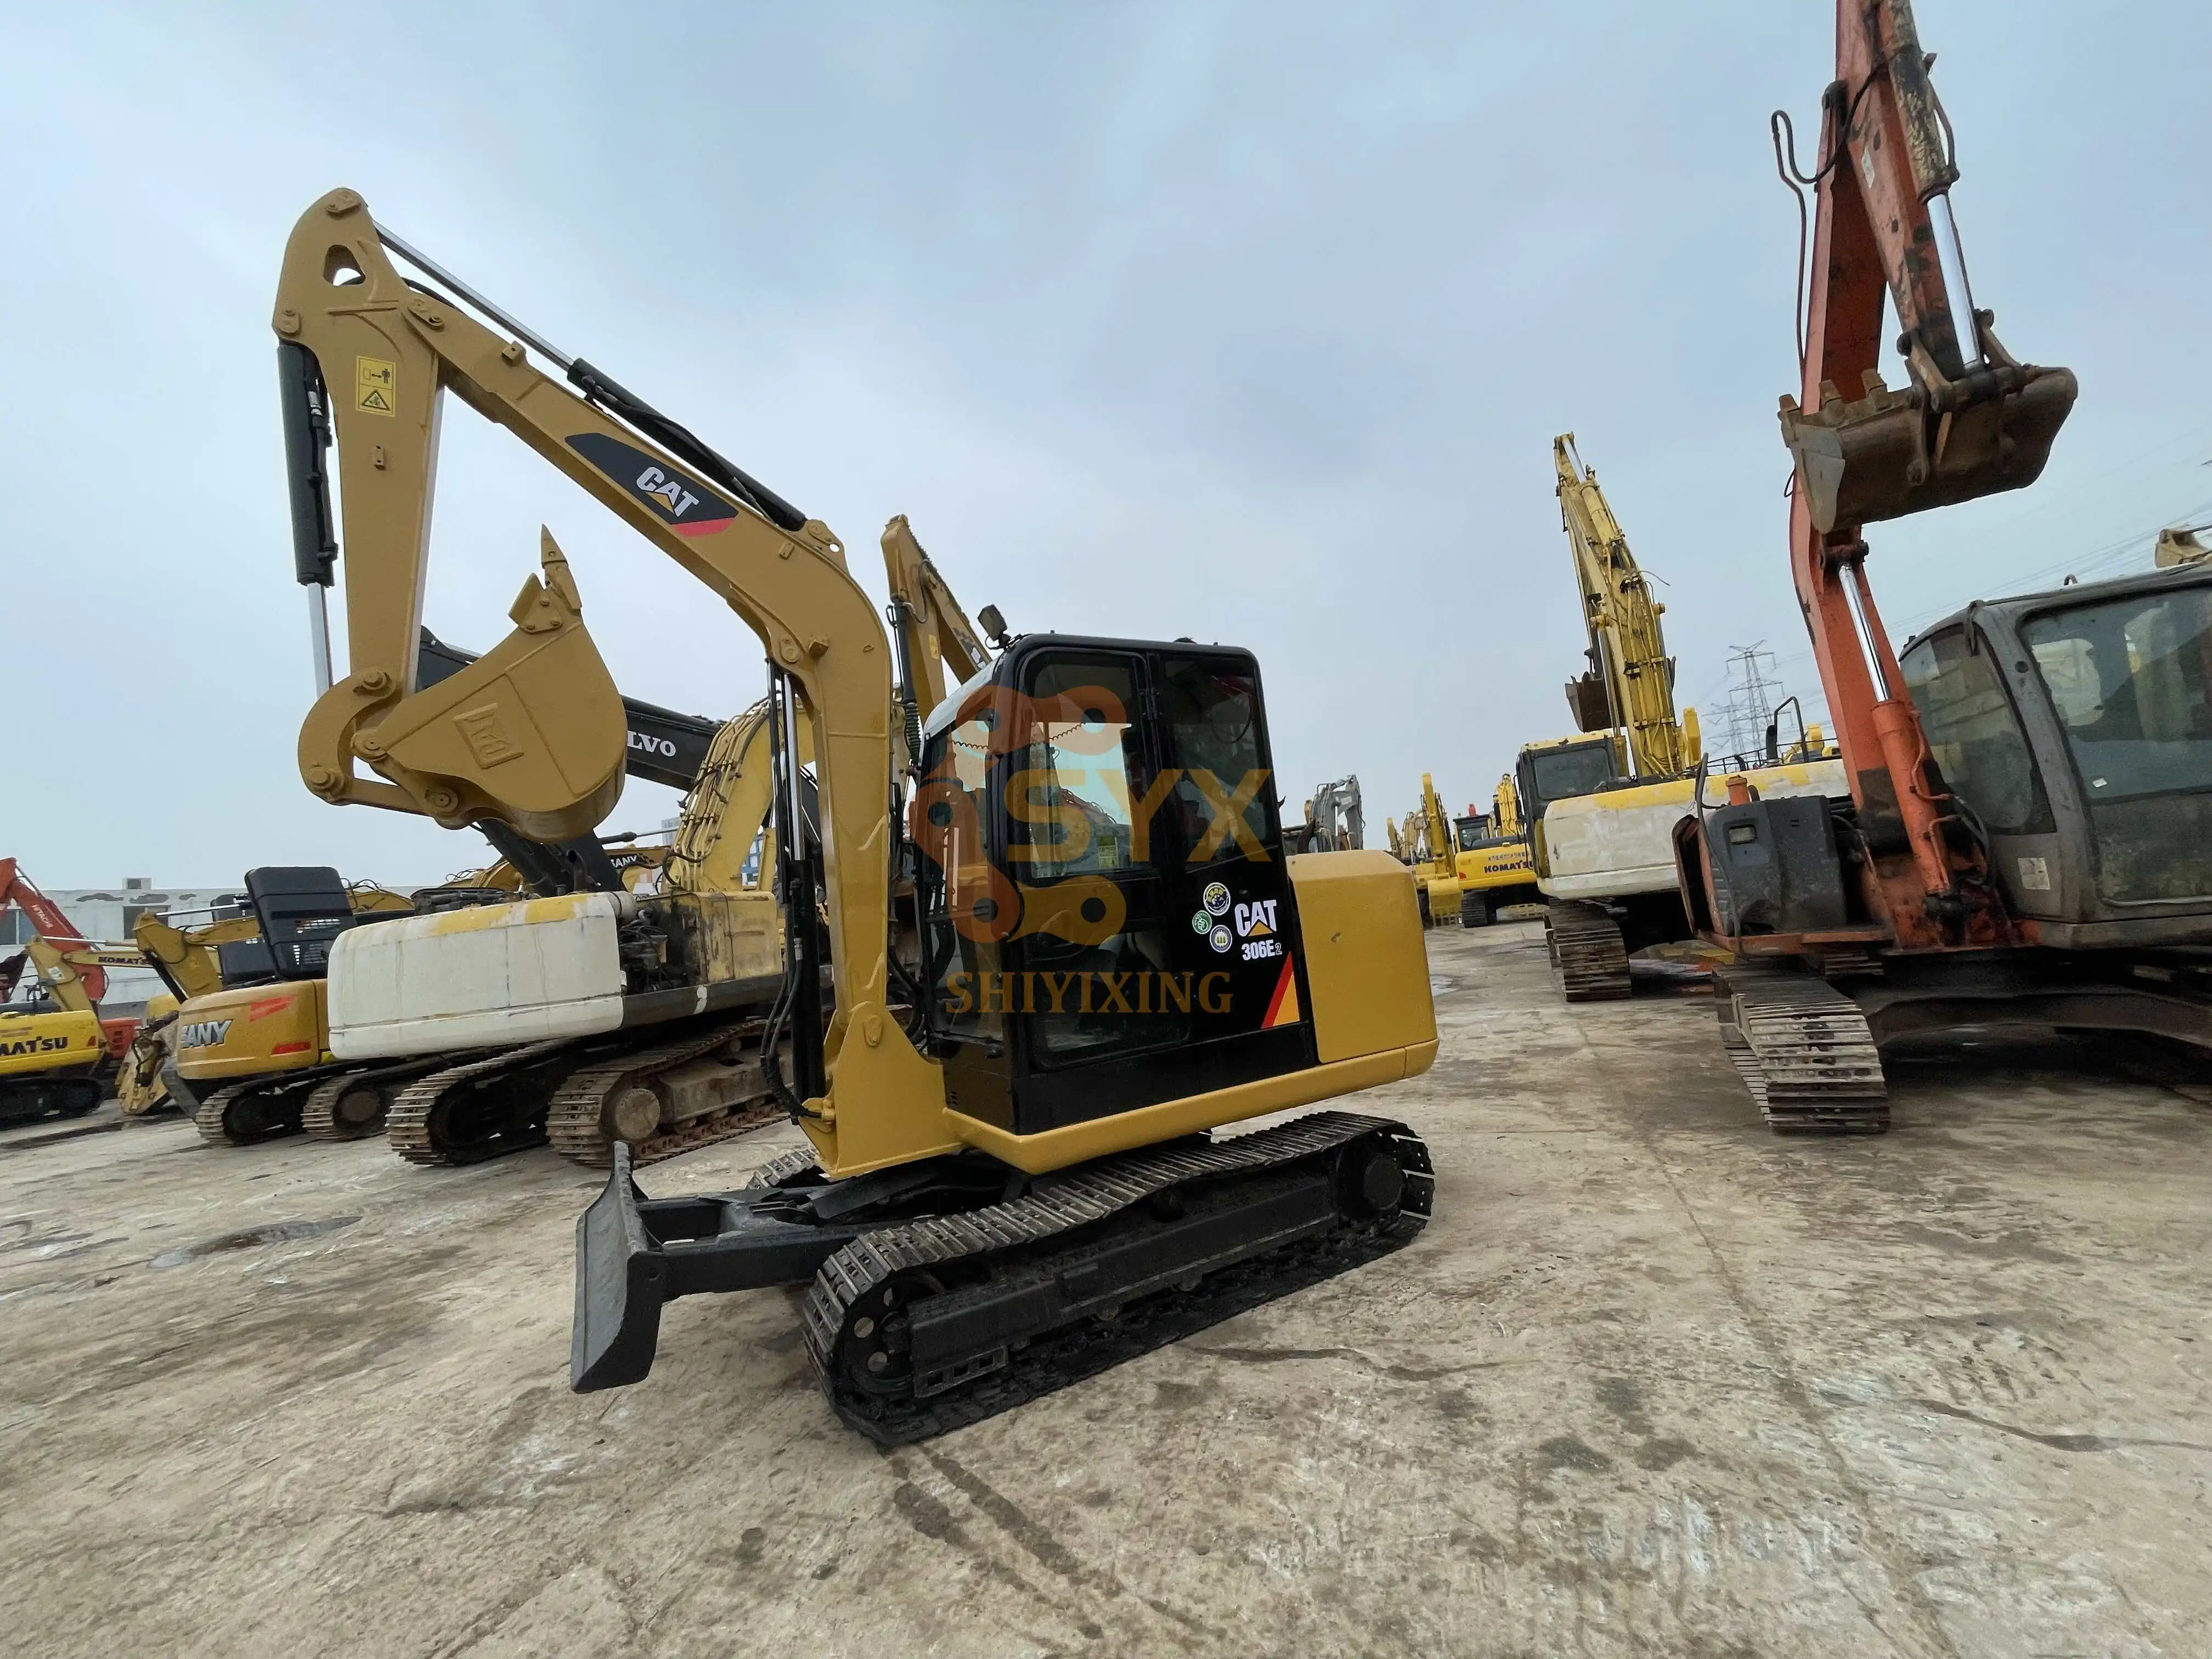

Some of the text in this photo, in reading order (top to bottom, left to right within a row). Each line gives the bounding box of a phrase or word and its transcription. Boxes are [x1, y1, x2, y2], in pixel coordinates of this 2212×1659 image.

[636, 466, 700, 517] CAT
[627, 730, 676, 757] LVO
[1234, 899, 1277, 937] CAT
